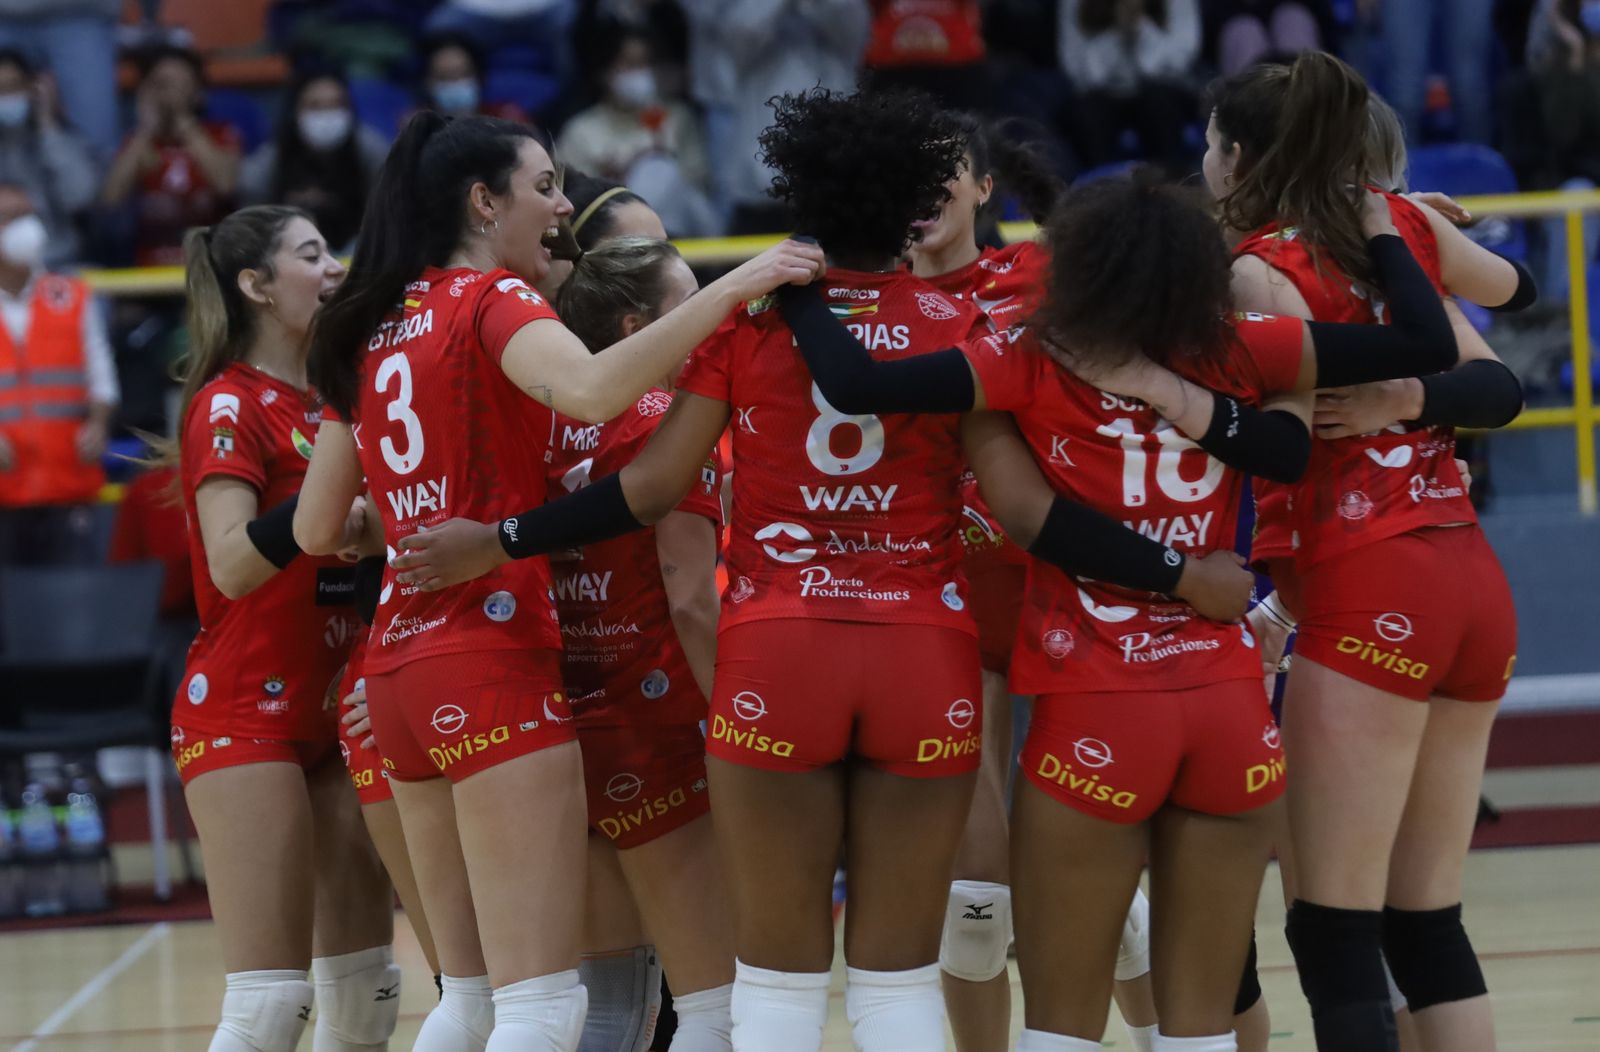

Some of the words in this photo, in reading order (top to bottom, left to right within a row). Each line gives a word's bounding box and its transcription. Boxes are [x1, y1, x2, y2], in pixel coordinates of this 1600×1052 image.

[374, 351, 424, 476] 3
[805, 380, 885, 476] 8
[386, 475, 448, 521] WAY
[799, 484, 898, 511] WAY
[1122, 510, 1214, 548] WAY
[555, 570, 613, 602] WAY
[1336, 635, 1430, 681] Divisa
[429, 725, 511, 772] Divisa
[712, 713, 796, 758] Divisa
[1036, 752, 1138, 809] Divisa
[598, 787, 687, 841] Divisa
